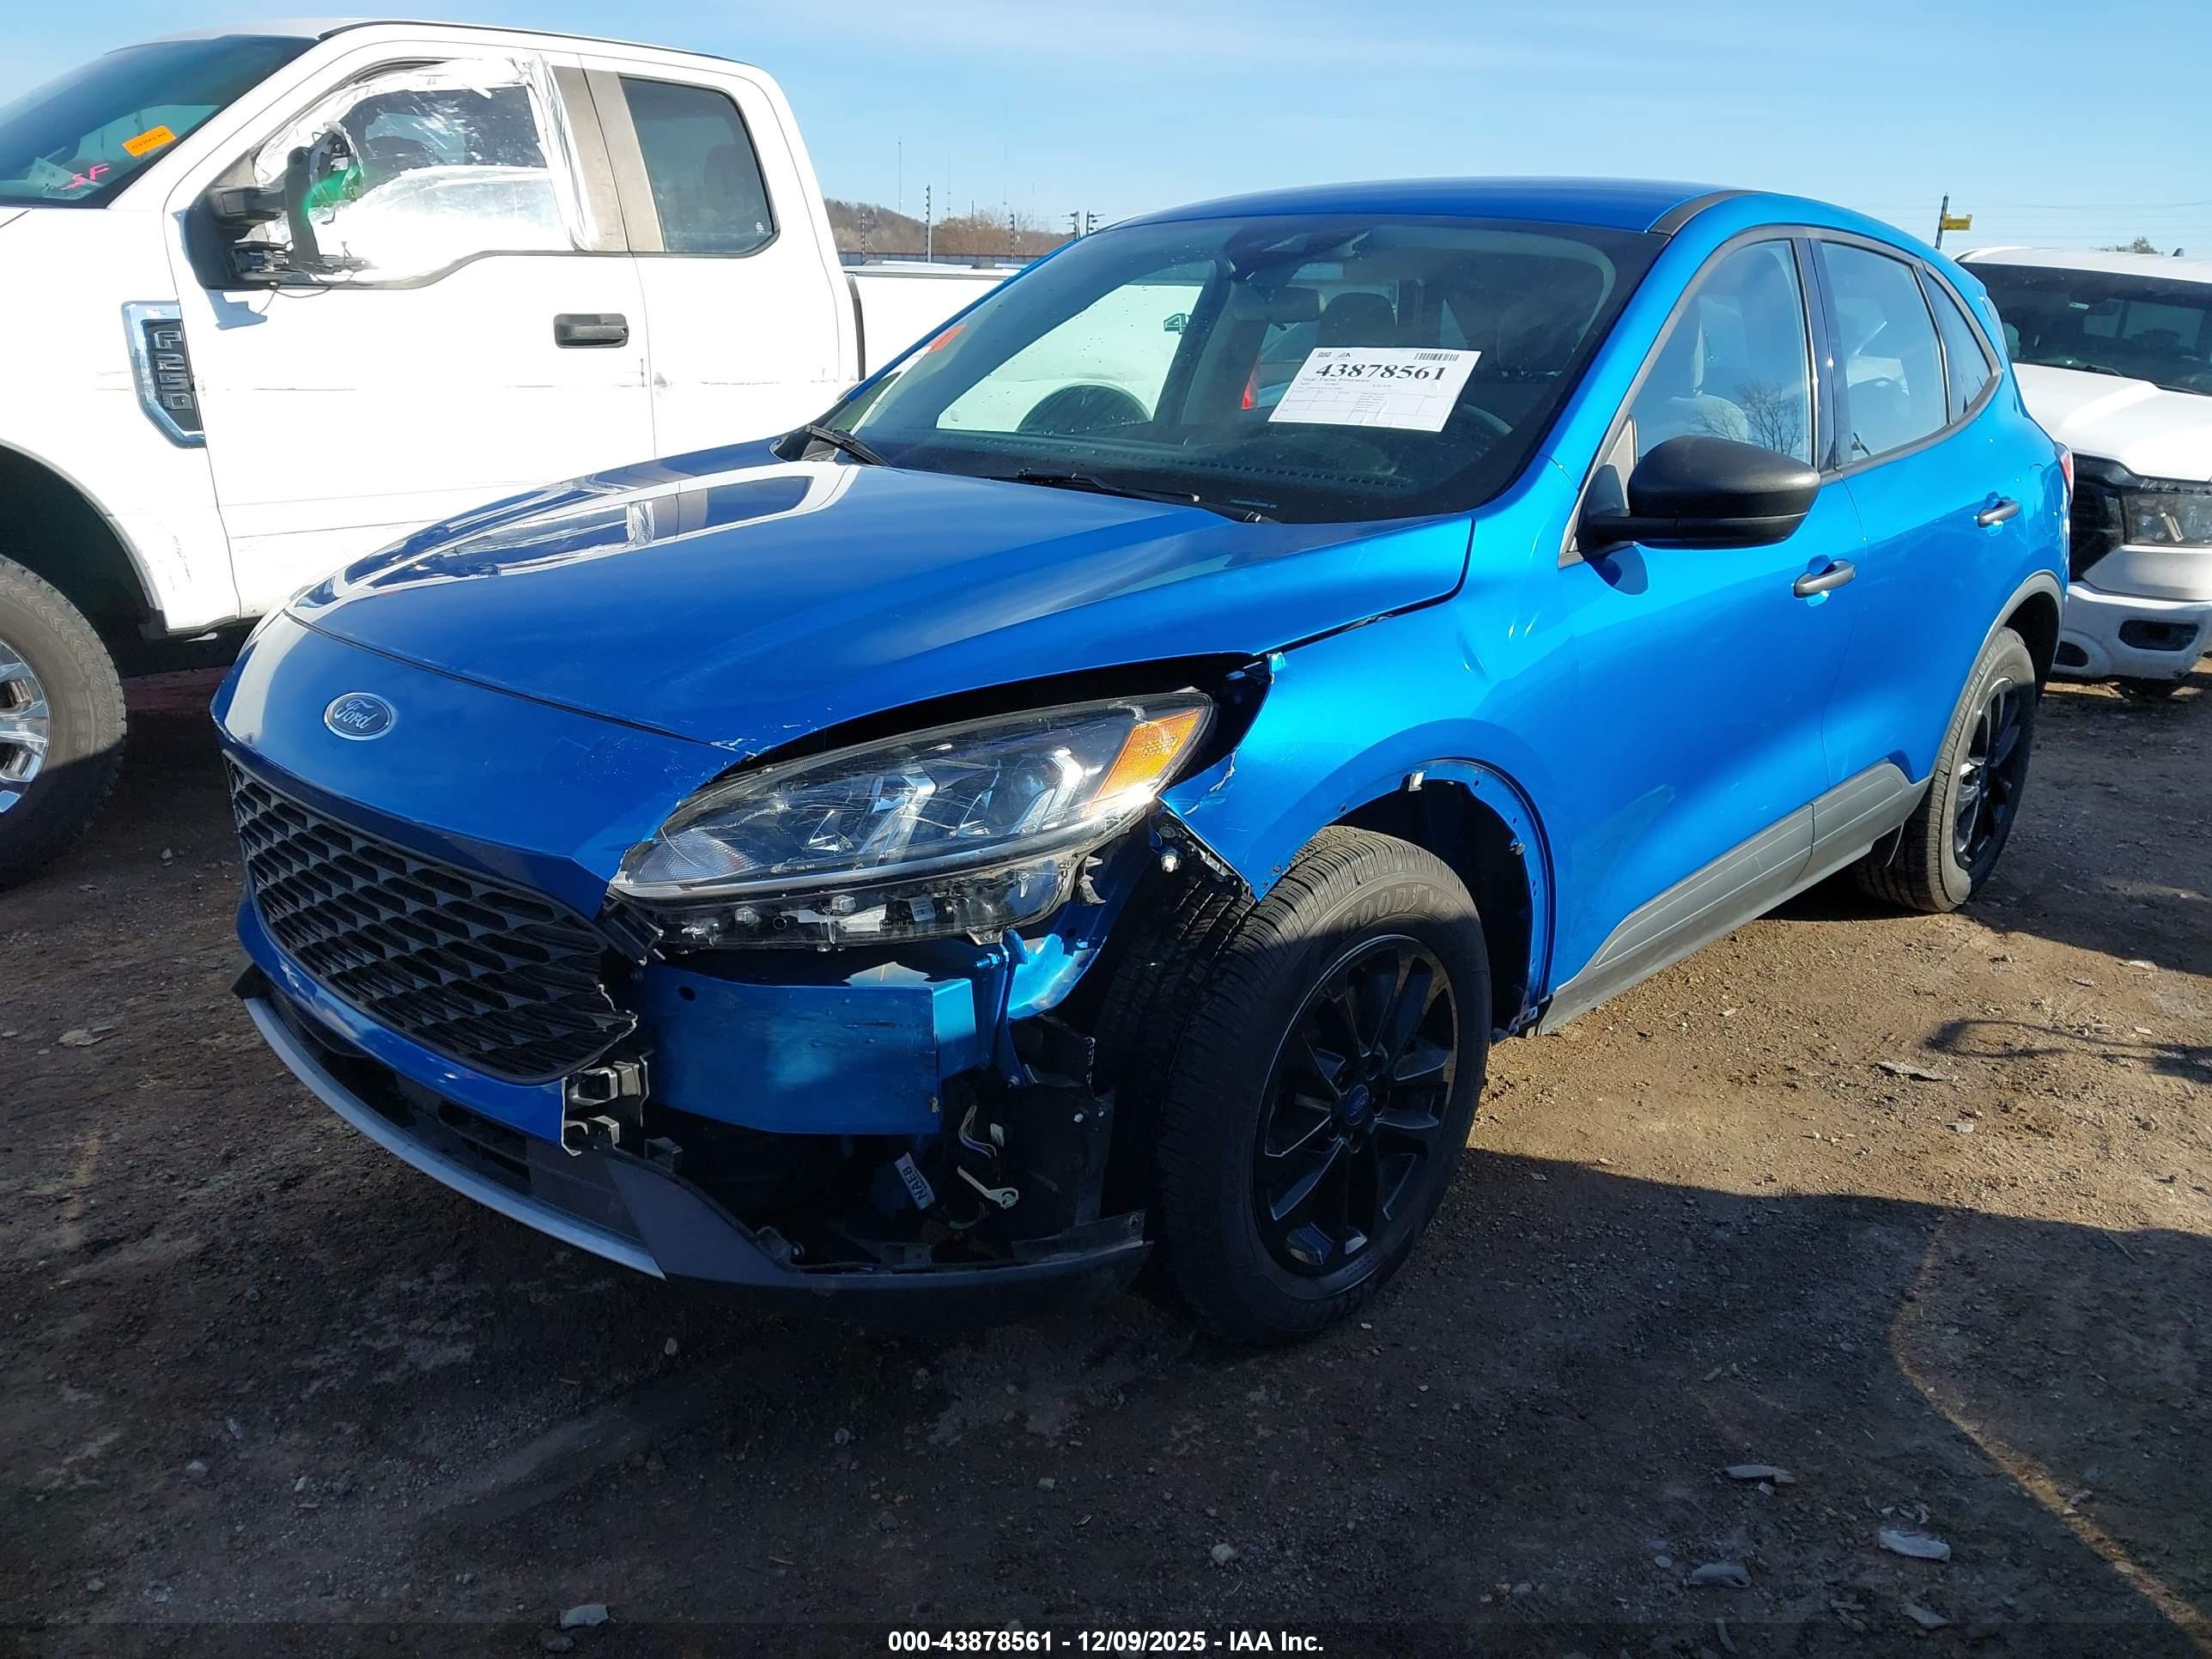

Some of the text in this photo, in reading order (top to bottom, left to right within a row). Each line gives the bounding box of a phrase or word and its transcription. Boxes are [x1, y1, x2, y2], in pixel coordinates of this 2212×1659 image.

[1316, 363, 1446, 380] 43878561
[334, 698, 379, 729] Ford
[902, 1165, 927, 1201] NAEB
